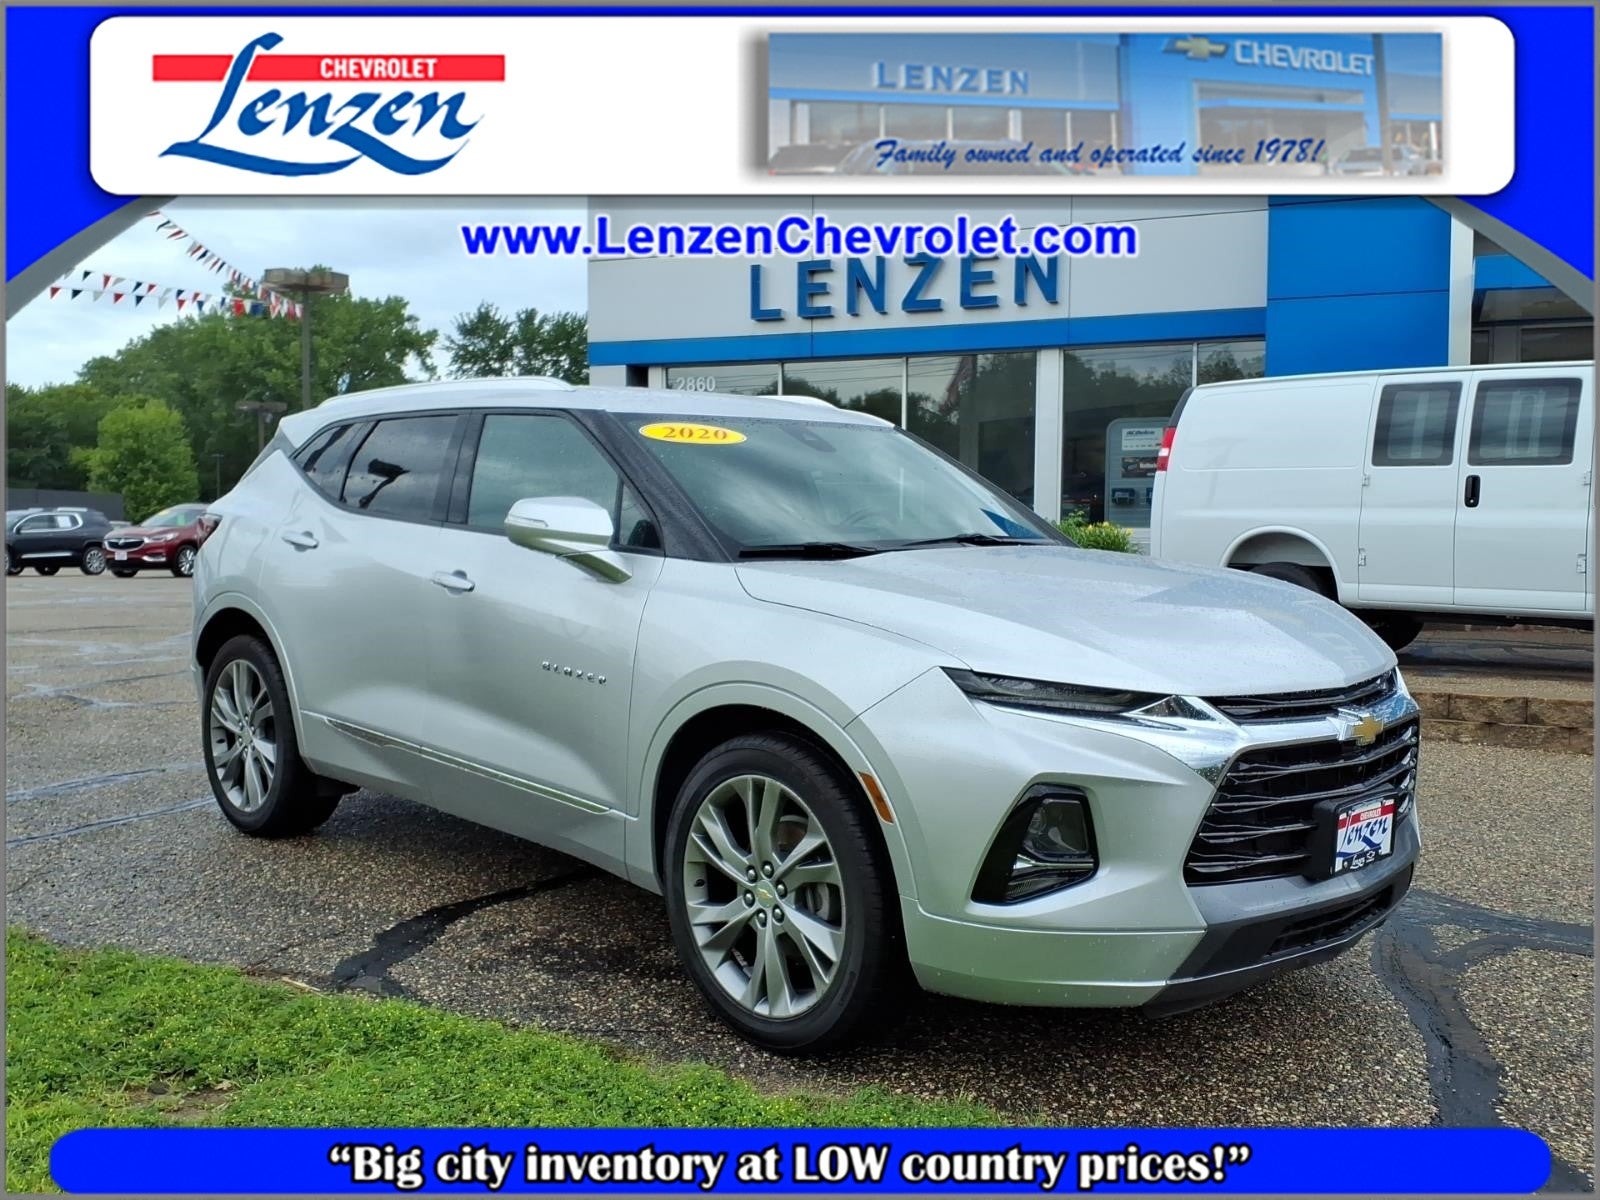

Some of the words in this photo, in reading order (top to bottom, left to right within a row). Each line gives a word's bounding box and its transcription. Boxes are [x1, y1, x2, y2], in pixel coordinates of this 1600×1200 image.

[750, 251, 1059, 321] LENZEN
[675, 376, 716, 392] 2860
[662, 426, 728, 441] 2020
